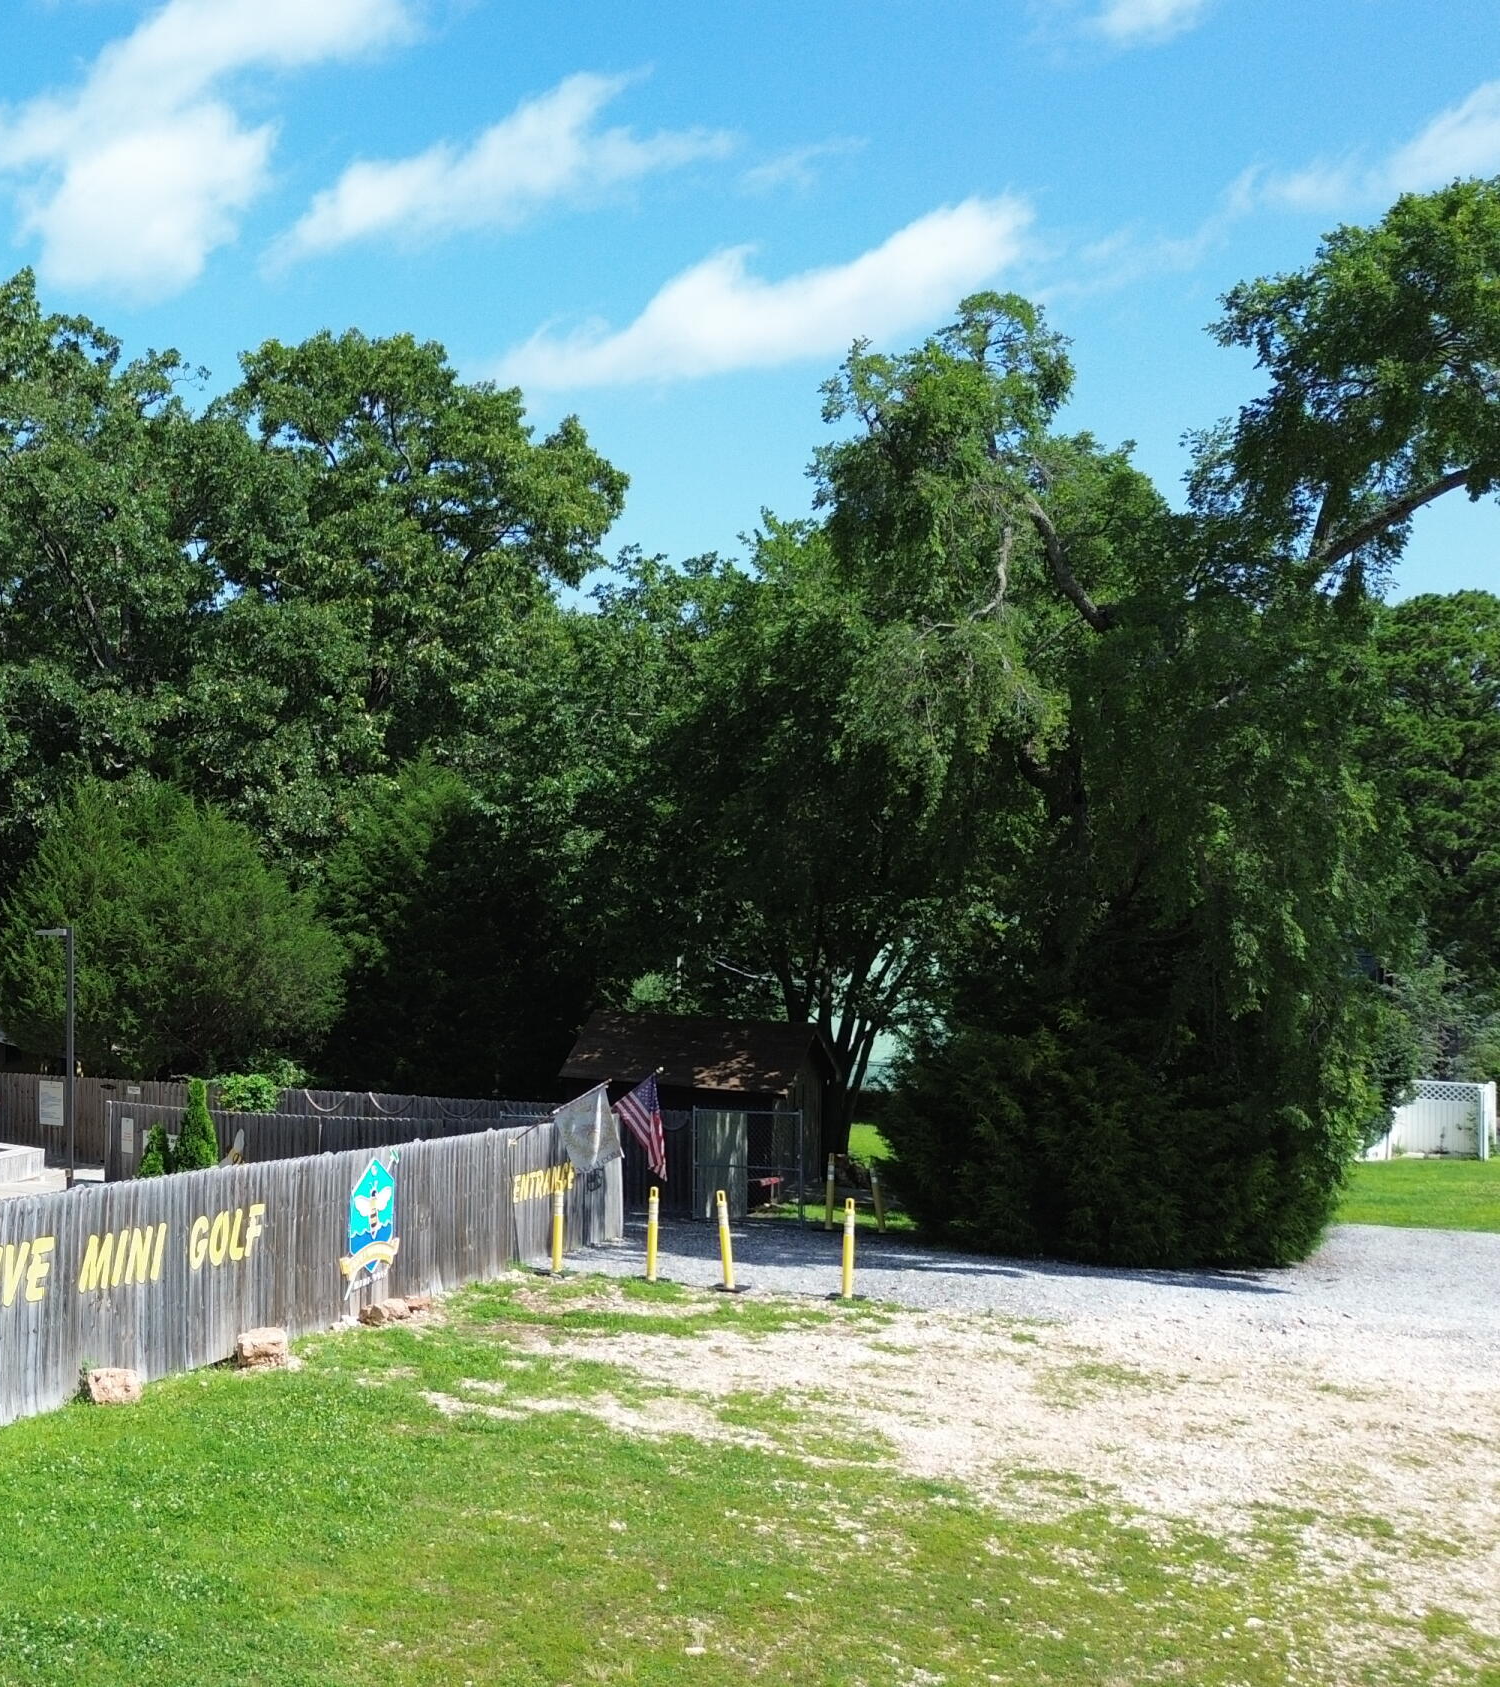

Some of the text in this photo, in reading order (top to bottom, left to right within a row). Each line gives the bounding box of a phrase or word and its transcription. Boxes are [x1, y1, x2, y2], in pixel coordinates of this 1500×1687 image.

[513, 1161, 575, 1204] ENTRANCE
[79, 1222, 167, 1293] MINI
[189, 1203, 266, 1271] GOLF
